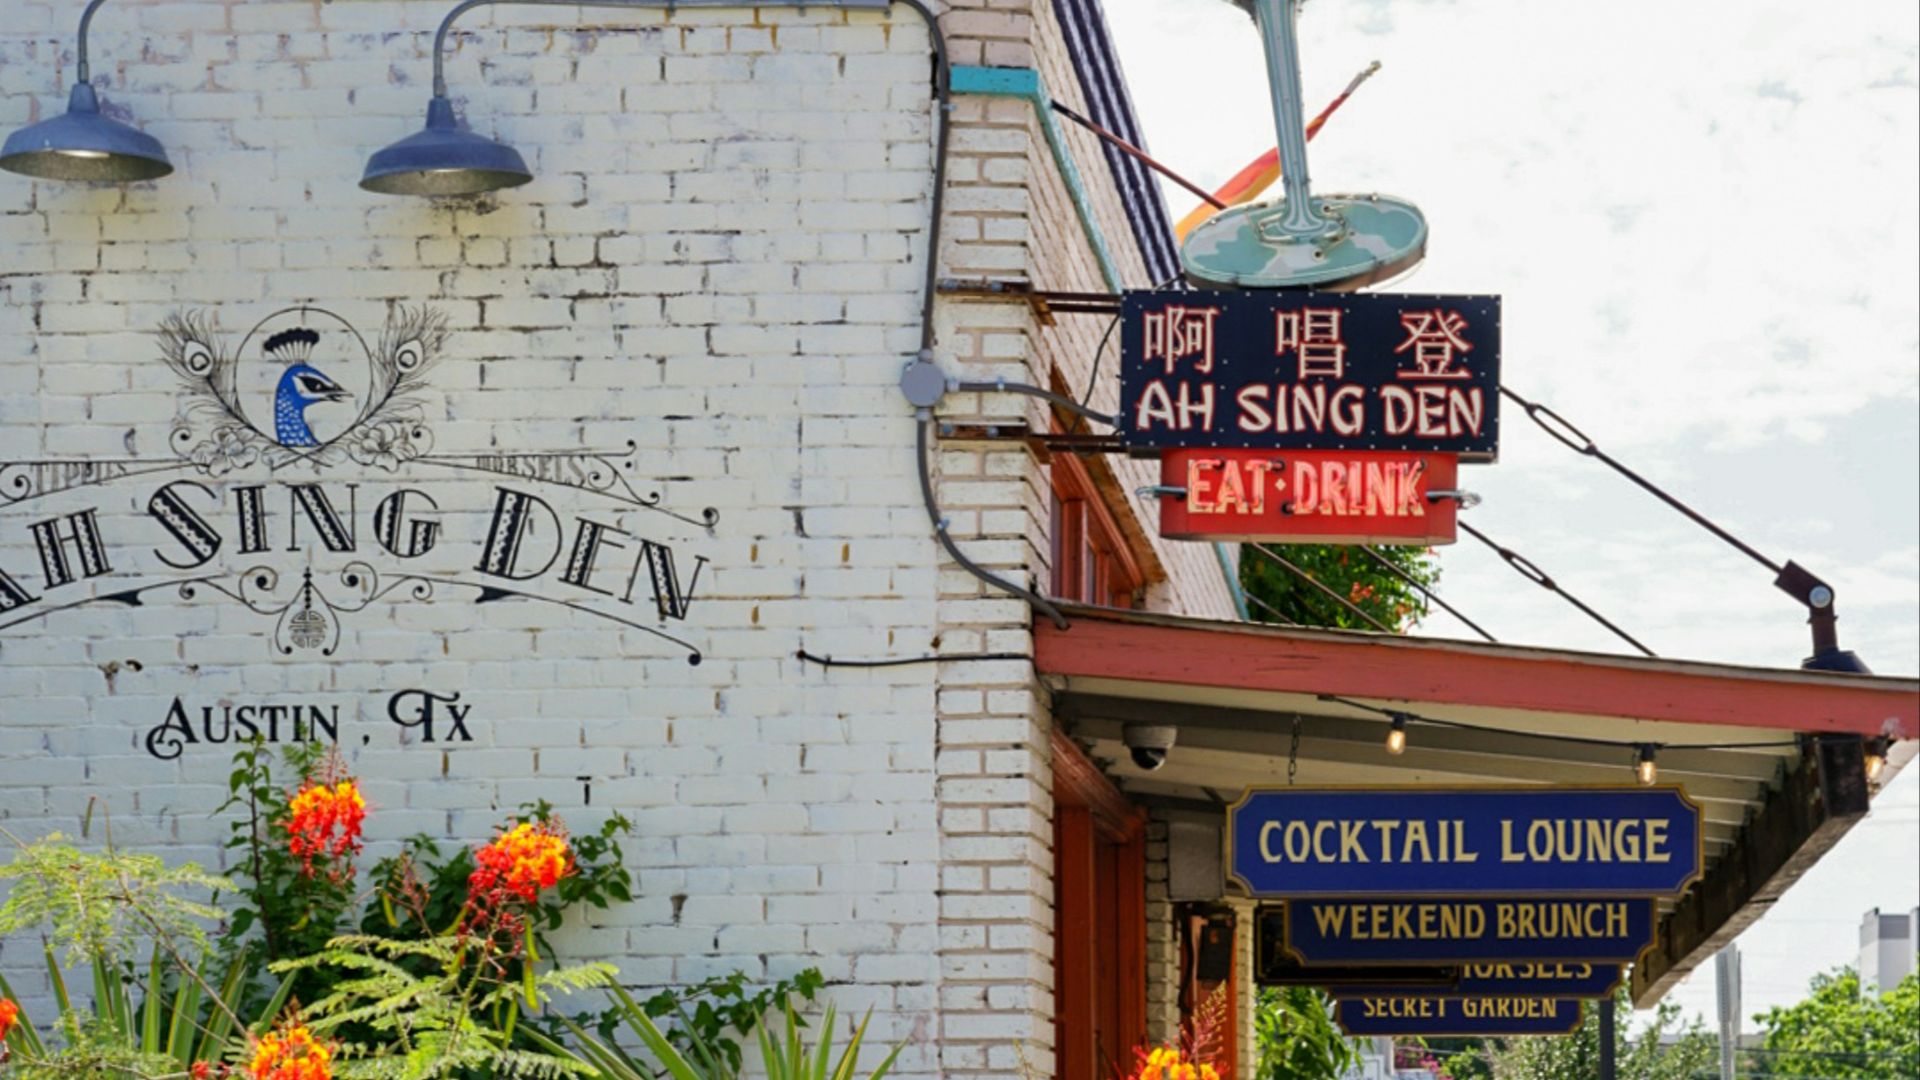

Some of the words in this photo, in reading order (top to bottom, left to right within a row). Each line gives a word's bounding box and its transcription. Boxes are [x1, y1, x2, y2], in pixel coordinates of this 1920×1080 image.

[1136, 381, 1215, 432] AH
[1236, 384, 1365, 437] SING
[1379, 385, 1484, 437] DEN
[1187, 459, 1273, 515] EAT
[1291, 460, 1425, 516] DRINK
[148, 480, 441, 569] SING
[473, 486, 709, 620] DEN
[1258, 820, 1479, 863] COCKTAIL
[1500, 818, 1671, 863] LOUNGE
[1312, 904, 1486, 940] WEEKEND
[1497, 902, 1629, 939] BRUNCH
[1463, 962, 1592, 978] ORSLS
[1363, 998, 1446, 1018] SECRET
[1462, 998, 1557, 1018] GARDEN
